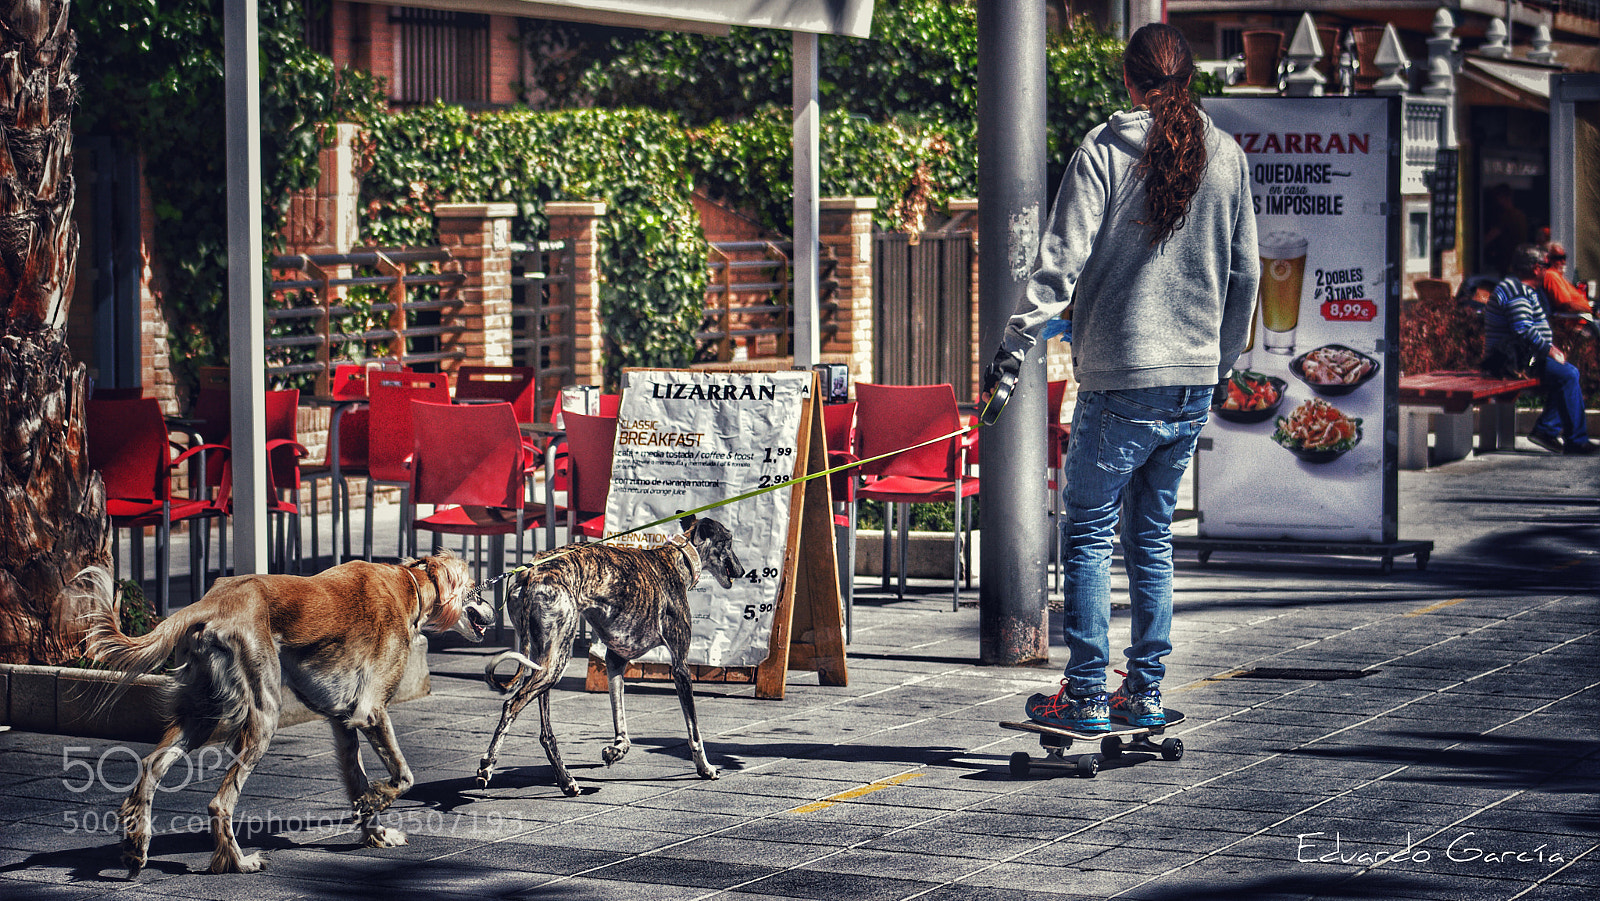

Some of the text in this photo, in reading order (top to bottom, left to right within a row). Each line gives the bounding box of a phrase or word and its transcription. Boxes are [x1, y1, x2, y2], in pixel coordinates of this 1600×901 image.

[1233, 133, 1370, 154] ZARRAN
[1254, 163, 1331, 184] QUEDARSE
[1269, 186, 1308, 195] en casa
[1252, 195, 1343, 215] S IMPOSIBLE
[1314, 268, 1363, 286] 2 DOBLES
[1325, 285, 1334, 303] 3
[1334, 285, 1364, 301] TAPAS
[652, 383, 776, 401] LIZARRAN
[620, 420, 659, 430] CLASSIC
[619, 431, 705, 447] BREAKFAST
[666, 450, 694, 459] tostada
[700, 451, 726, 460] coffee
[734, 452, 754, 460] toast
[651, 477, 662, 486] de
[662, 479, 691, 488] naranja
[649, 488, 671, 496] orange
[606, 531, 671, 543] INTERNATION
